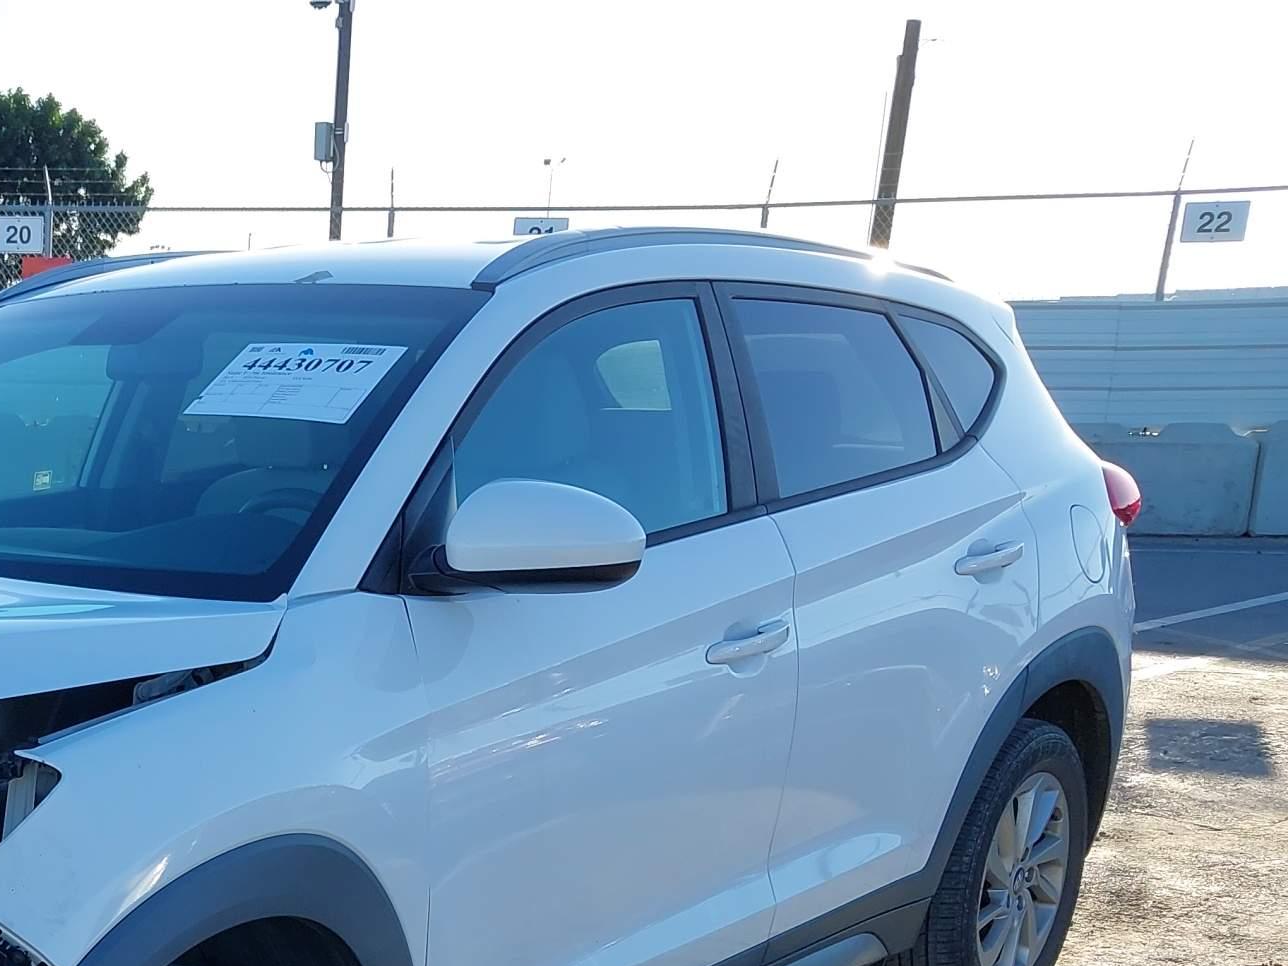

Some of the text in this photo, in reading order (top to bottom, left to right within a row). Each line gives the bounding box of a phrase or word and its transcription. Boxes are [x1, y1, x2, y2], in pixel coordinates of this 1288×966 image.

[1196, 211, 1233, 233] 22
[6, 225, 31, 244] 20
[243, 357, 374, 374] 44430707
